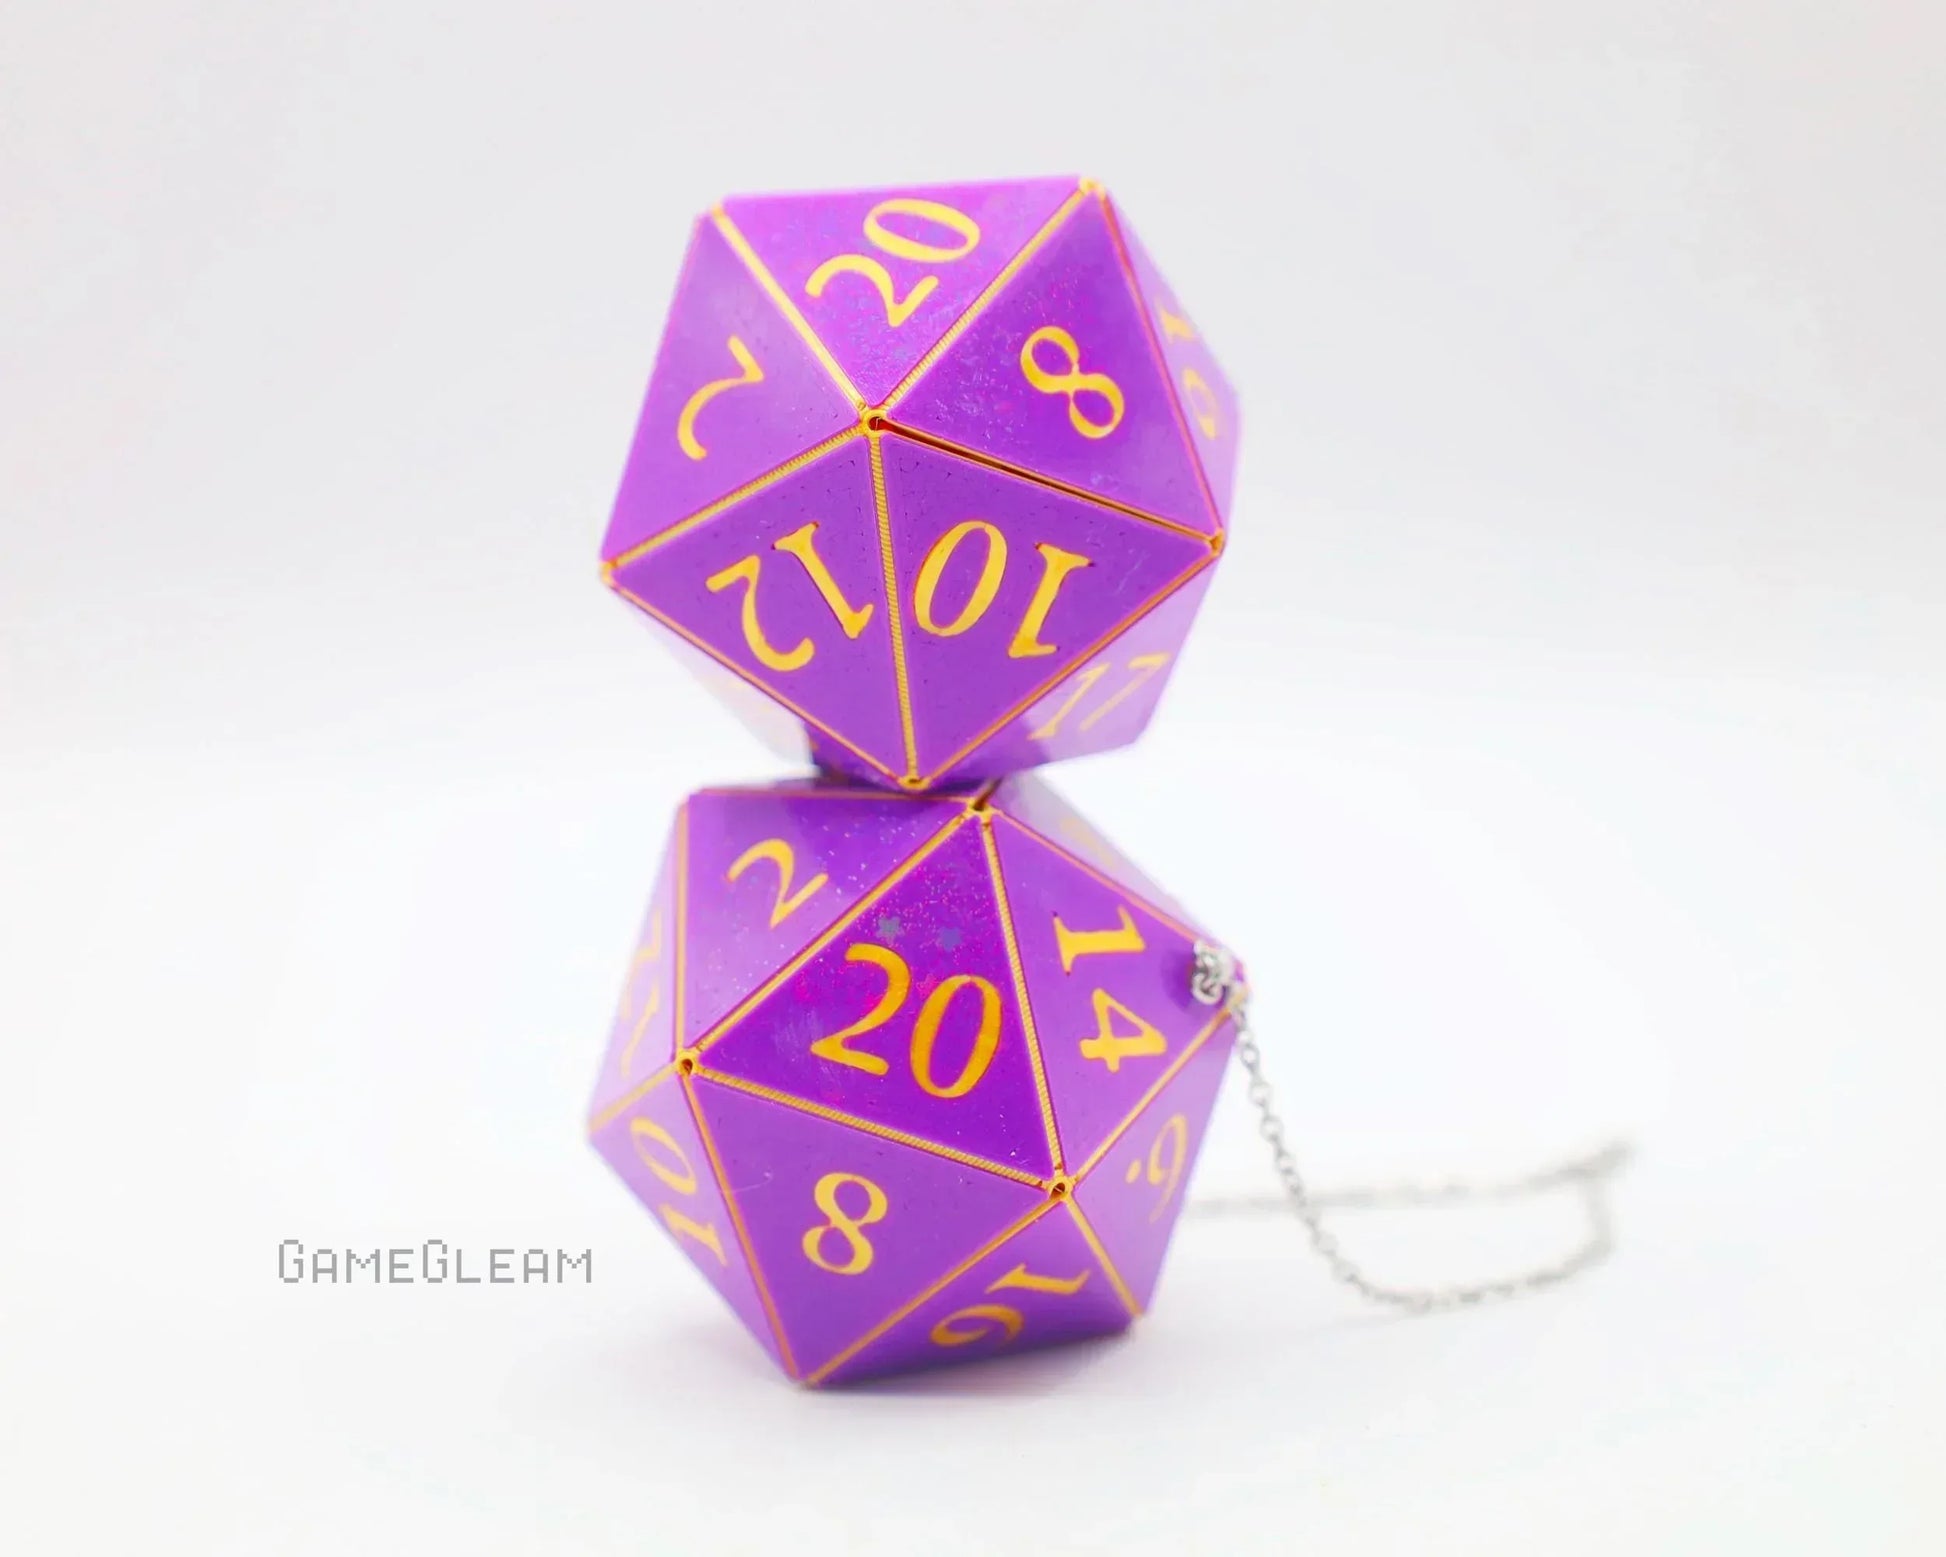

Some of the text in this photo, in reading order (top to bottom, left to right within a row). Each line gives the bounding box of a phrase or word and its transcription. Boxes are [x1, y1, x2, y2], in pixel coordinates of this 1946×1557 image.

[805, 198, 981, 327] 20
[1019, 326, 1125, 439] 8
[705, 522, 874, 672] 12
[912, 520, 1094, 659] 10
[1027, 652, 1170, 741] 17
[726, 838, 828, 928] 2
[810, 942, 1003, 1099] 20
[1053, 904, 1167, 1072] 14
[629, 1115, 728, 1267] 10
[802, 1172, 889, 1275] 8
